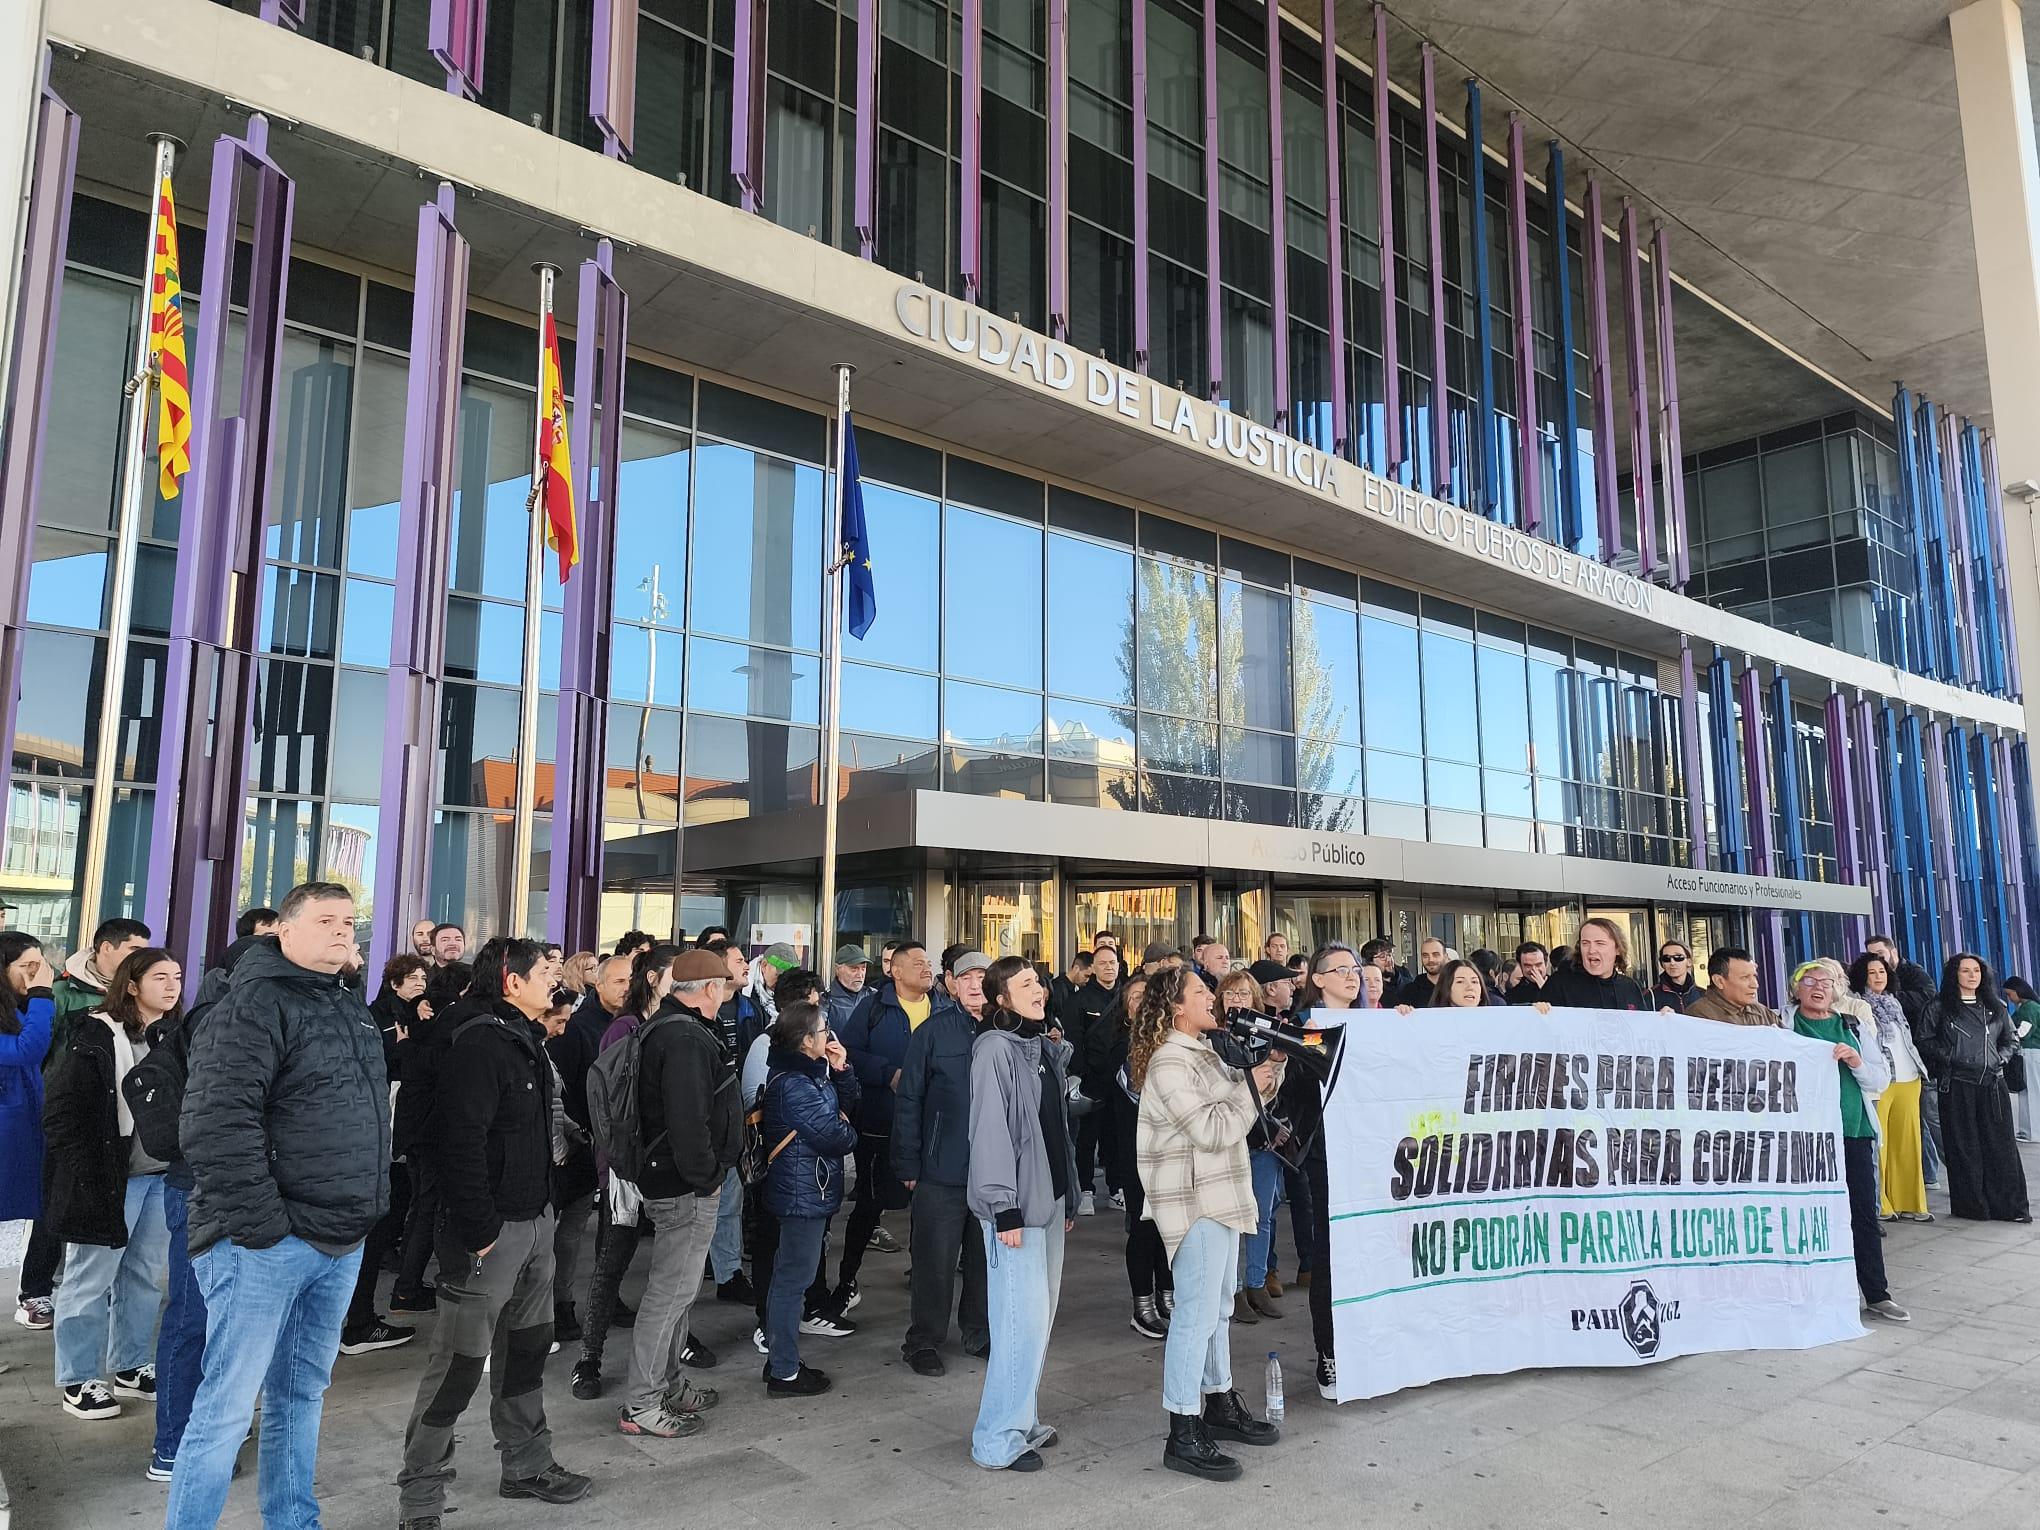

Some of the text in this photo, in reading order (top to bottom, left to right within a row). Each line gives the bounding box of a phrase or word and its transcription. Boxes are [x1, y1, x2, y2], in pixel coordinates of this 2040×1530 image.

[896, 283, 1341, 498] CIUDAD DE LA JUSTICIA
[1364, 474, 1654, 613] EDIFICIO FUEROS DE ARAGÓN
[1311, 841, 1366, 866] Público
[1667, 873, 1802, 900] Acceso Funcionarios y Profesionales
[1464, 1053, 1799, 1115] FIRMES PARA VENCER
[1391, 1127, 1839, 1200] SOLIDARIAS PARA CONTINUAR
[1412, 1220, 1447, 1278] NO
[1453, 1205, 1551, 1272] PODRÁN
[1671, 1207, 1739, 1259] LUCHA
[1743, 1205, 1775, 1255] DE
[1781, 1207, 1809, 1254] LA
[1571, 1309, 1620, 1331] PAH
